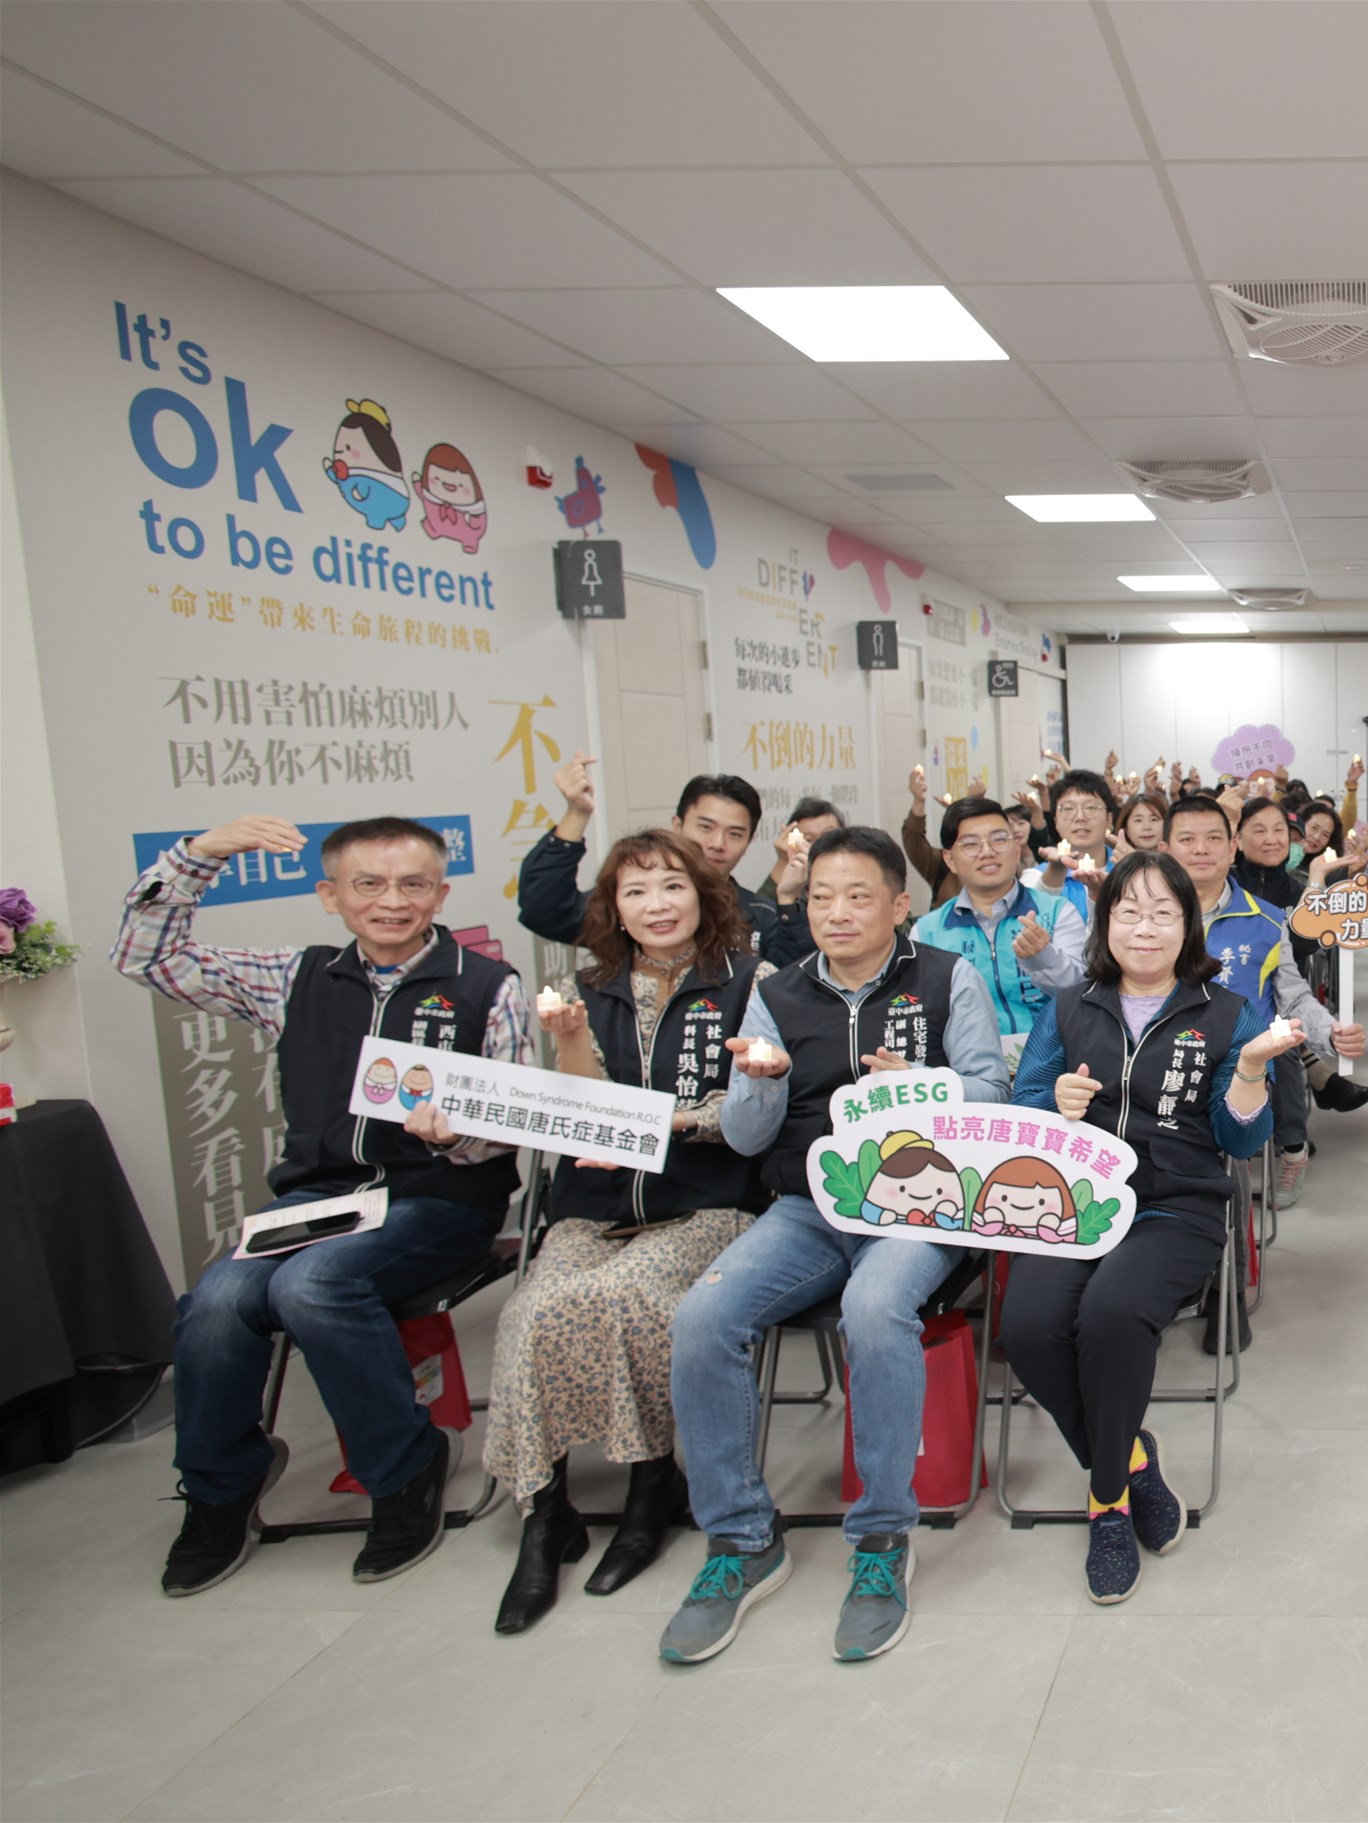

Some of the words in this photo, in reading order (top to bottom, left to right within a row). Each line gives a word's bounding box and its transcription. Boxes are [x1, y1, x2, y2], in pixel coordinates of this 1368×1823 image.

[114, 300, 212, 386] It's
[139, 499, 205, 560] to
[226, 513, 294, 575] be
[312, 536, 495, 610] different
[158, 674, 470, 731] 不用害怕麻煩別人
[168, 737, 415, 789] 因為你不麻煩
[741, 719, 856, 771] 不倒的力量
[1307, 891, 1368, 915] 不倒的
[703, 1024, 722, 1079] 社會局
[1184, 1051, 1207, 1103] 社會局
[445, 1072, 500, 1097] 財團法人
[510, 1086, 536, 1099] Down
[538, 1091, 583, 1111] Syndrome
[584, 1099, 636, 1121] Foundation
[843, 1082, 949, 1123] 永續ESG
[172, 1010, 246, 1265] 更多看見
[441, 1093, 660, 1157] 中華民國唐氏症基金會
[933, 1115, 1121, 1179] 點亮唐寶寶希望
